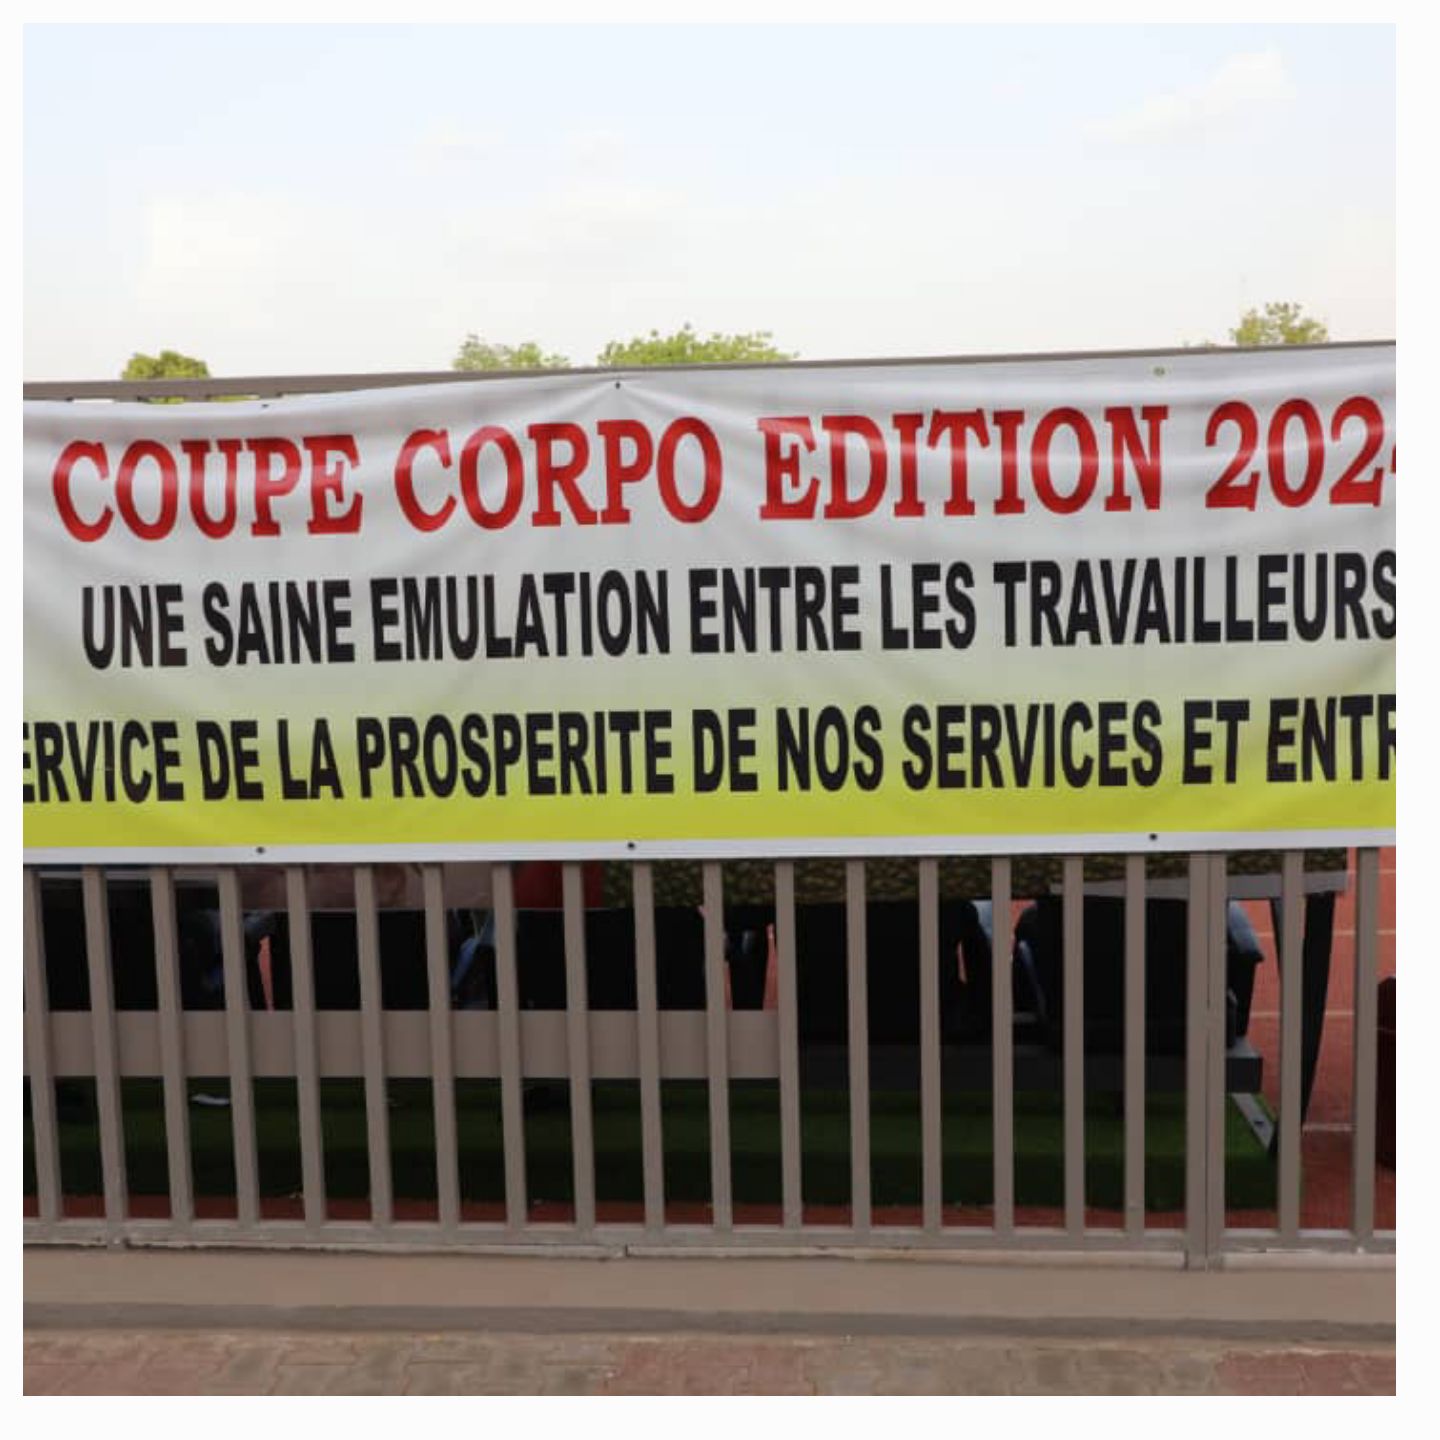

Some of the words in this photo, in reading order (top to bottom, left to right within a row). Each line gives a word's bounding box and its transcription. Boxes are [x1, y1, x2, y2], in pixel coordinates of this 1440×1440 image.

[52, 435, 364, 544] COUPE
[393, 417, 724, 533] CORPO
[758, 405, 1169, 521] EDITION
[1205, 396, 1396, 511] 202
[81, 583, 188, 671] UNE
[202, 579, 356, 667] SAINE
[369, 569, 670, 662] EMULATION
[688, 565, 863, 654] ENTRE
[880, 561, 977, 651] LES
[993, 549, 1396, 647] TRAVAILLEURS
[195, 720, 265, 801] DE
[277, 718, 344, 800] LA
[356, 709, 675, 799] PROSPERITE
[692, 707, 759, 793] DE
[775, 704, 884, 792] NOS
[901, 699, 1164, 791] SERVICES
[1182, 699, 1250, 785] ET
